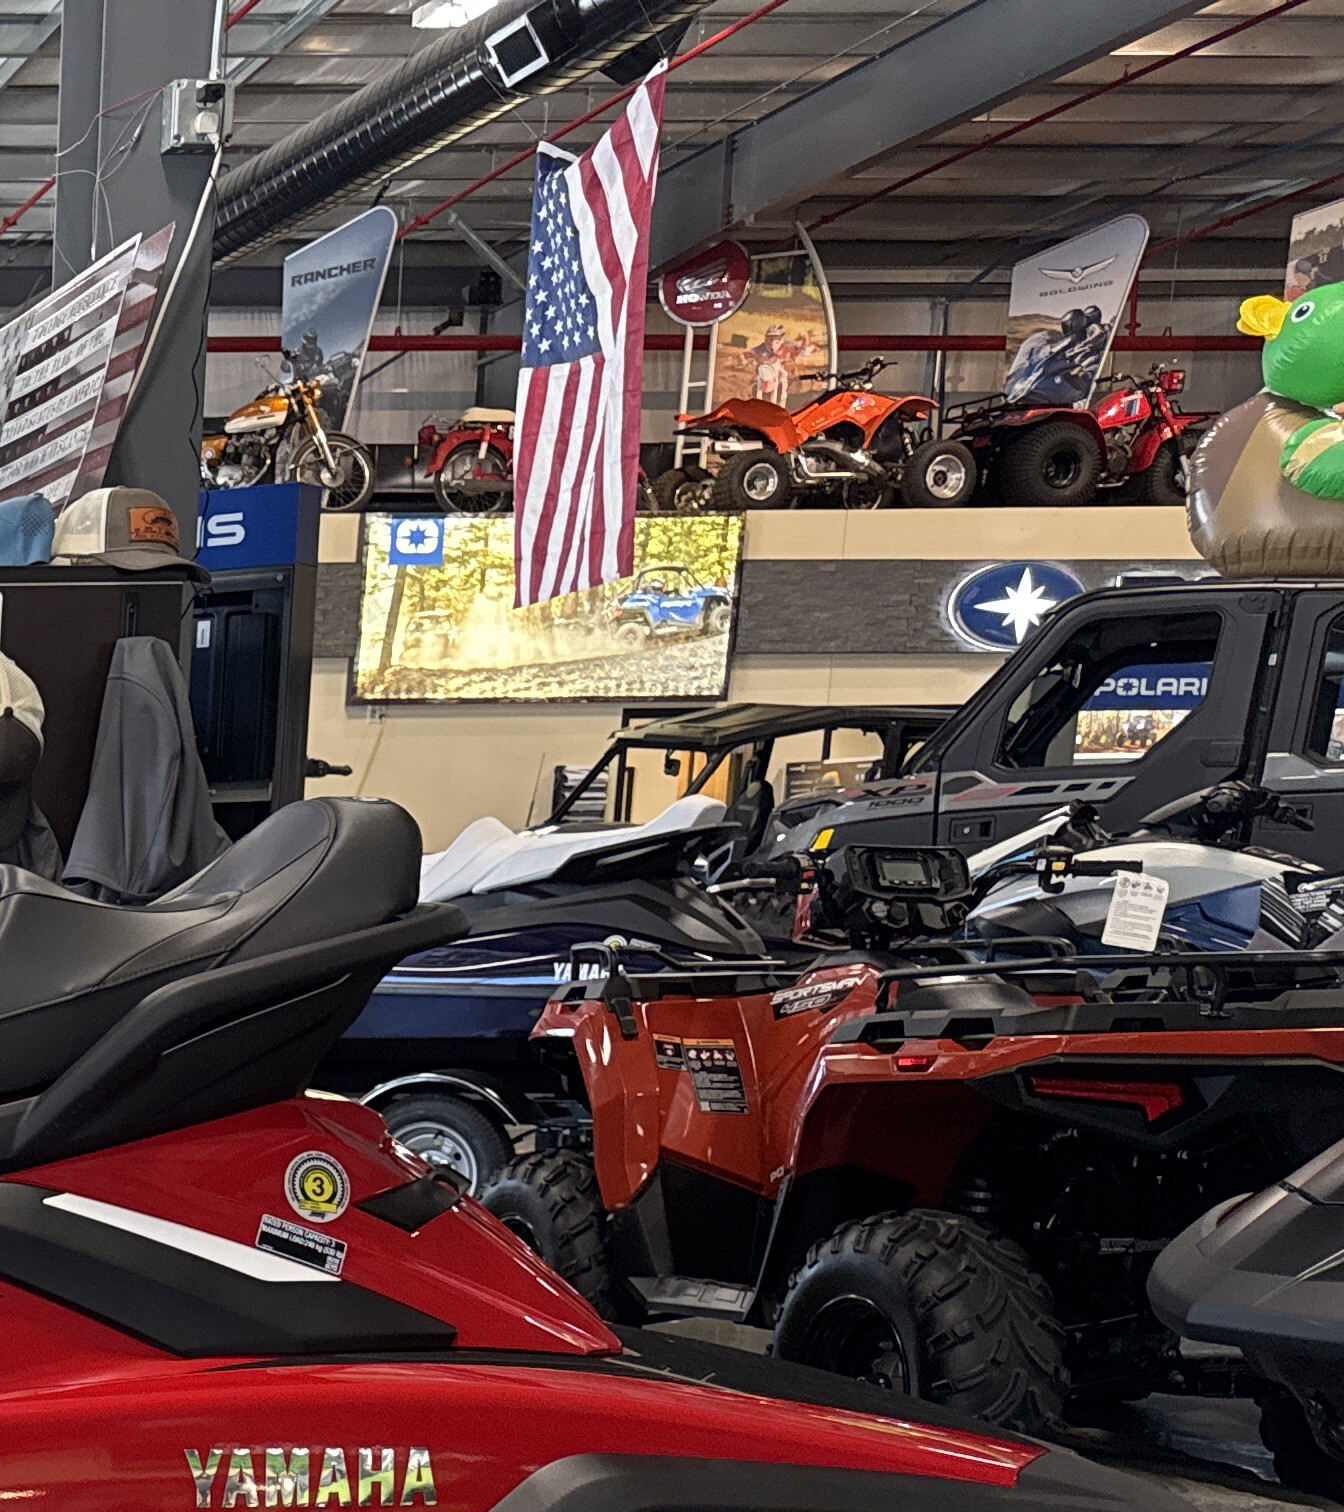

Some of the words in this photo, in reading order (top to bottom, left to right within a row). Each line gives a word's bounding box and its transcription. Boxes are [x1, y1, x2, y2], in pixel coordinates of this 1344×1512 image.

[291, 258, 377, 287] RANCHER
[770, 973, 872, 1005] SPORTSMAN
[311, 1176, 325, 1197] 3
[184, 1446, 437, 1508] YAMAHA
